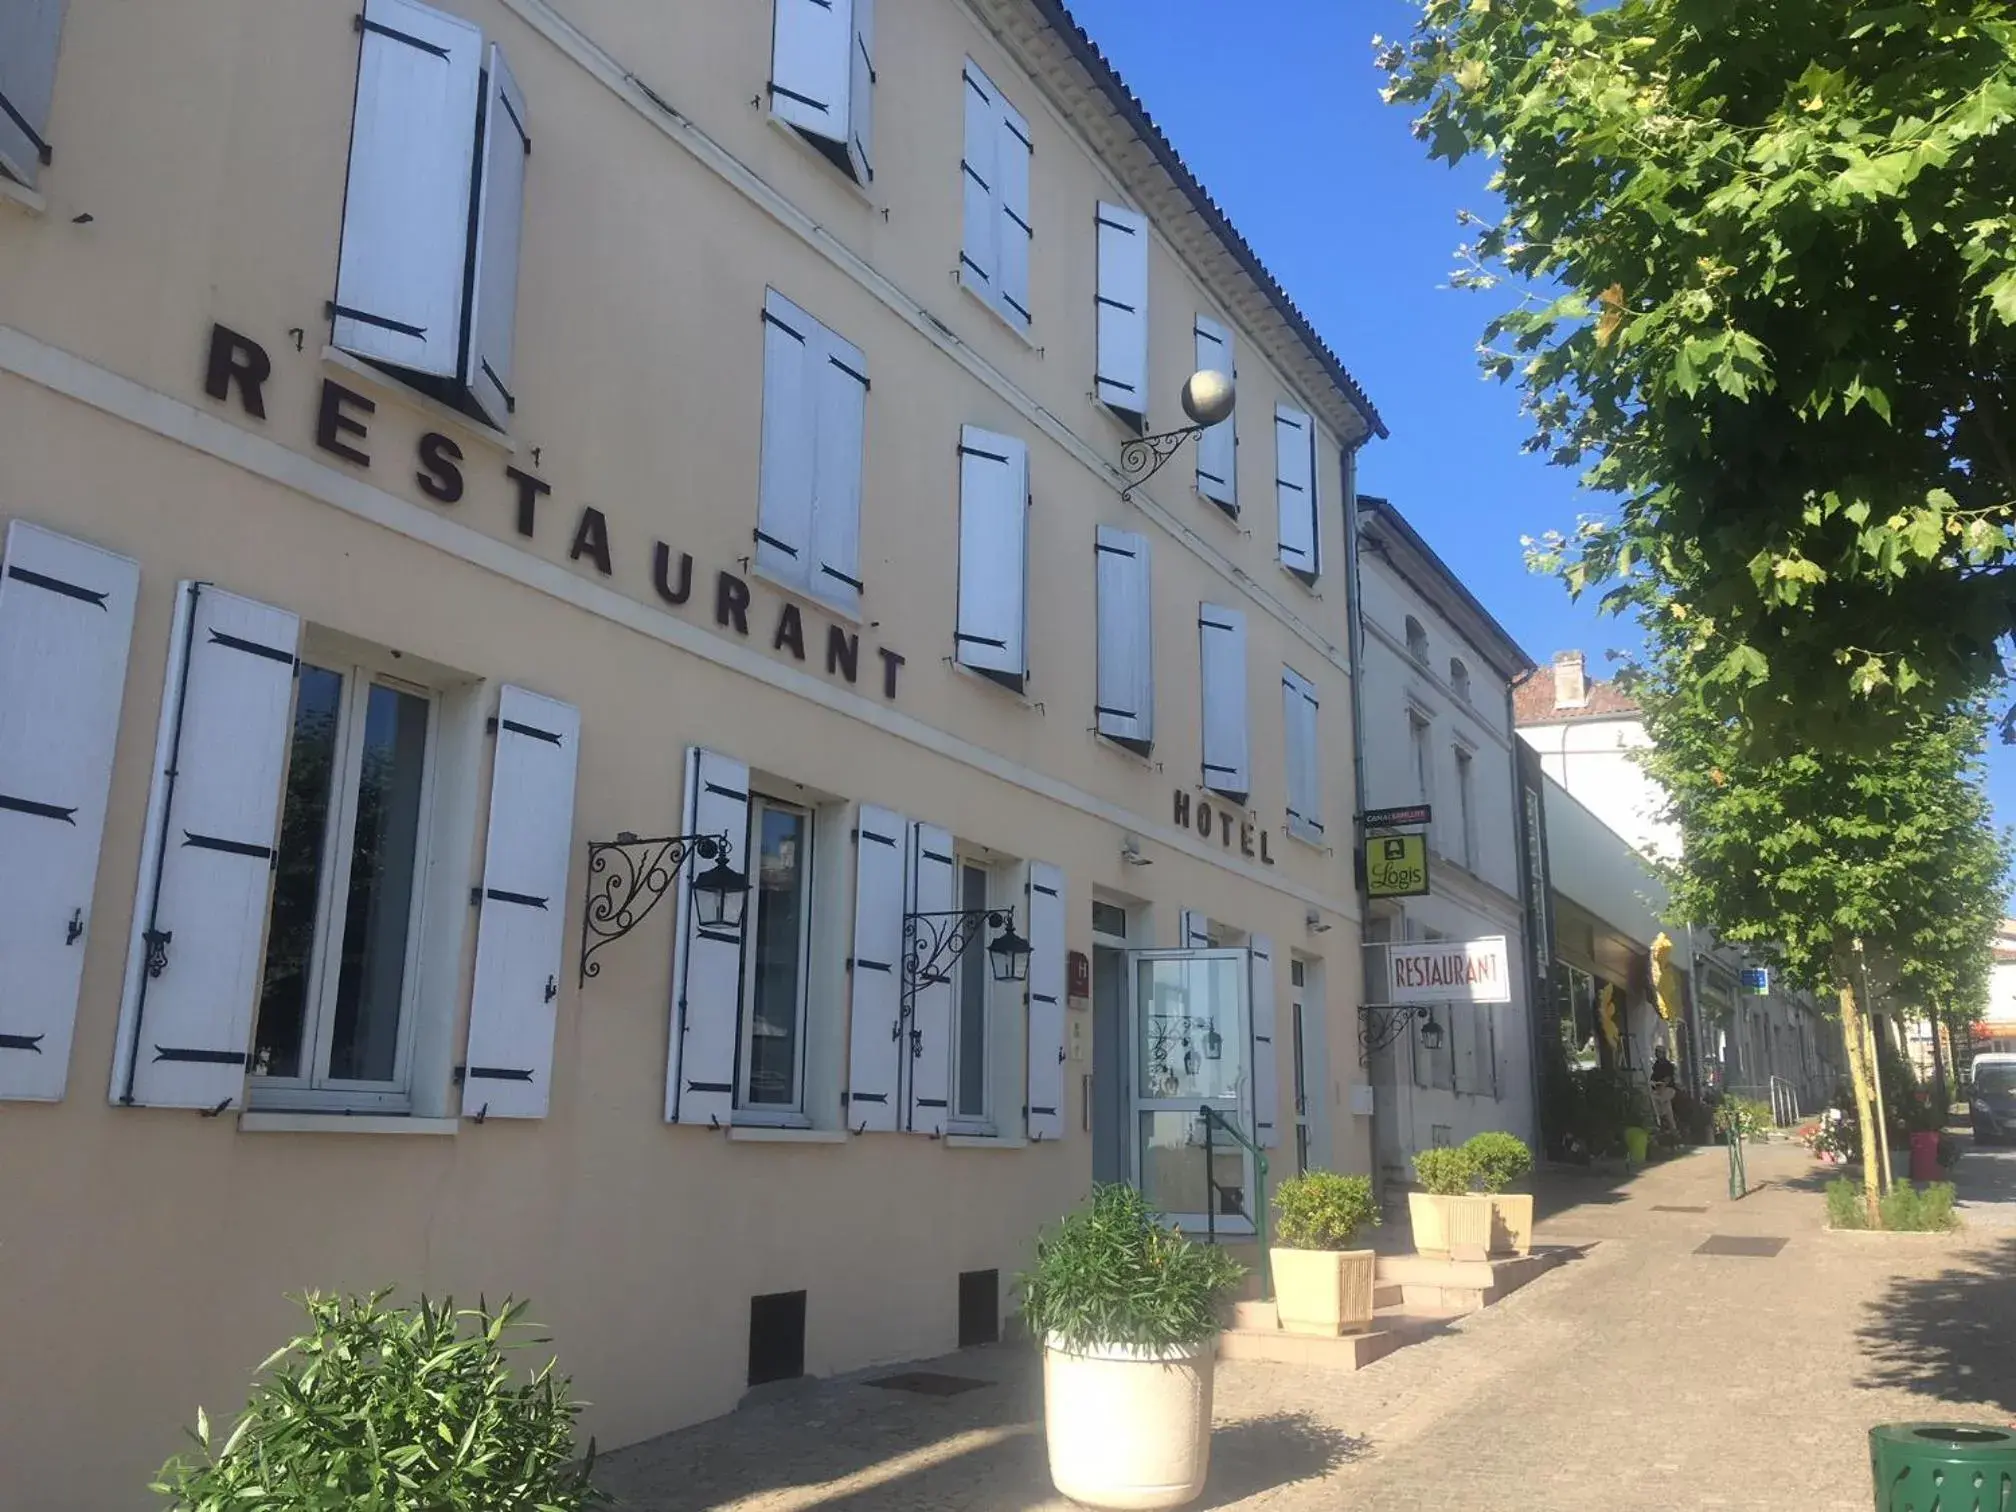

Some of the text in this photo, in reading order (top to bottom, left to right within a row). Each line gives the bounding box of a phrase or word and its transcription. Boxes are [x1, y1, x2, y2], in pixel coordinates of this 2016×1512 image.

[205, 322, 906, 700] RESTAURANT
[1173, 789, 1275, 865] HOTEL
[1370, 861, 1422, 890] Logis
[1395, 953, 1497, 988] RESTAURANT
